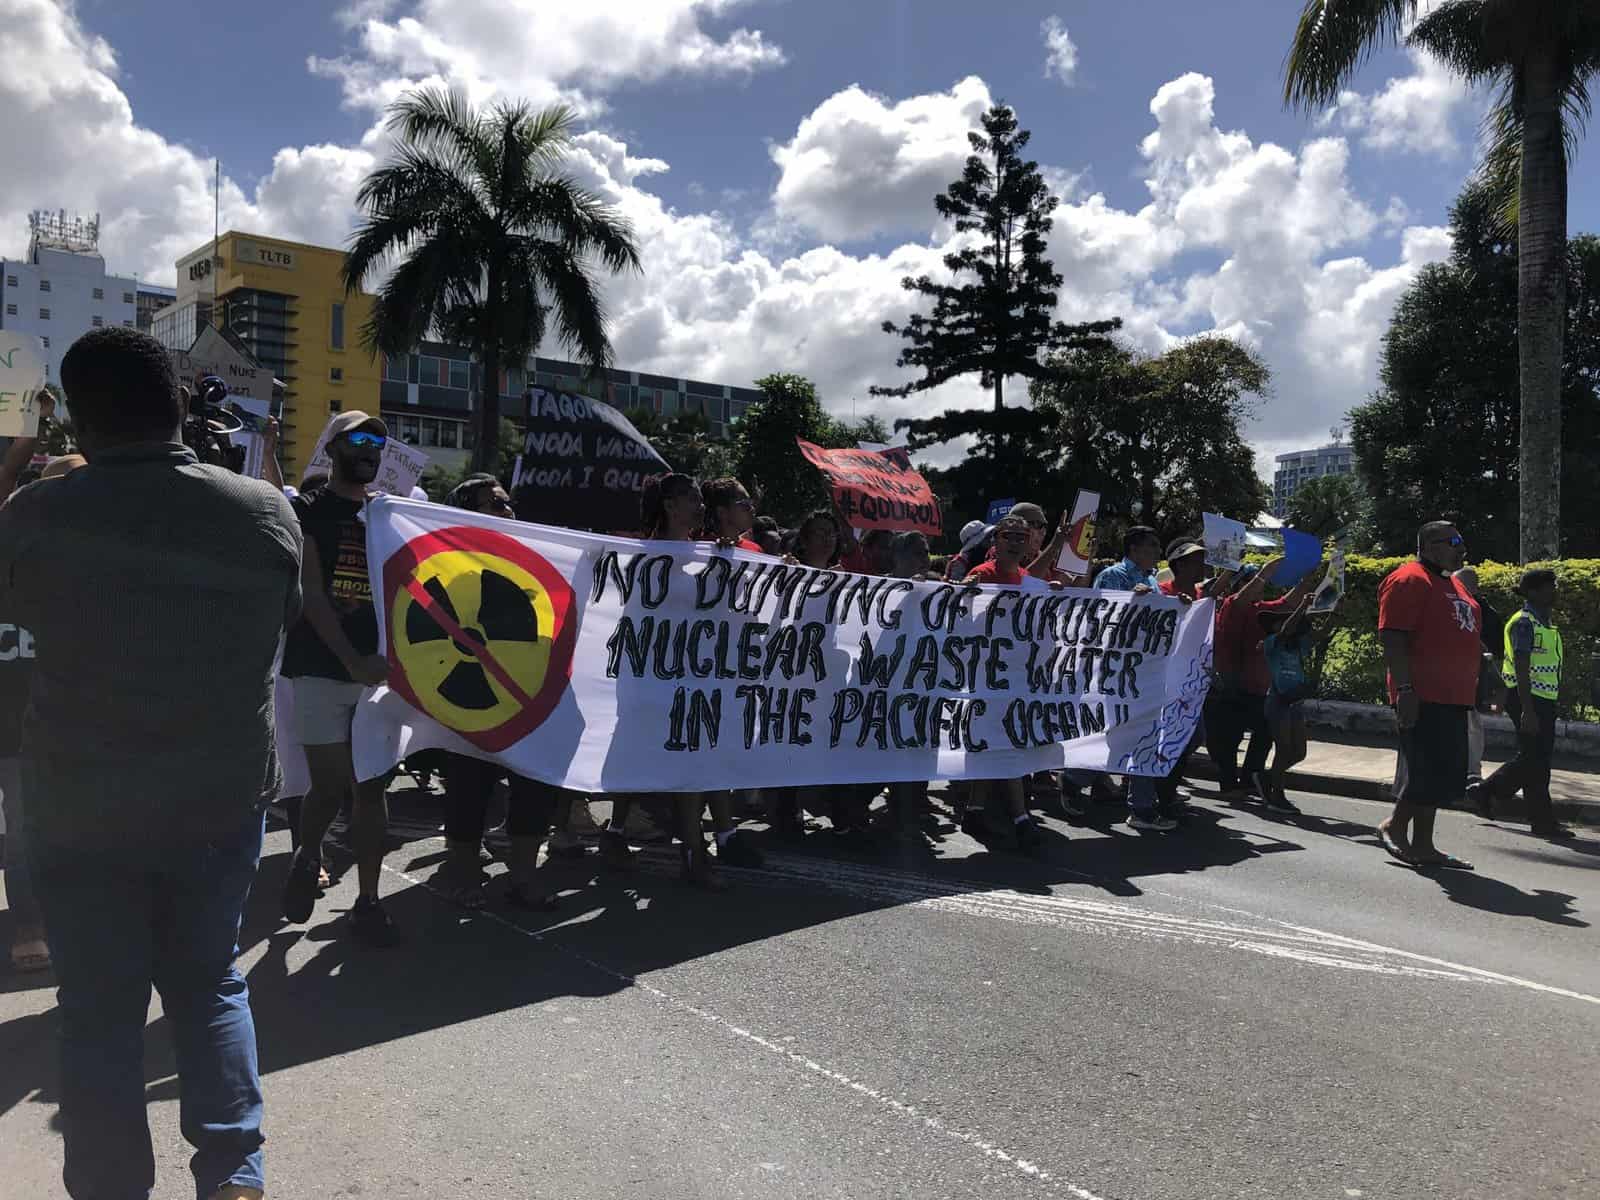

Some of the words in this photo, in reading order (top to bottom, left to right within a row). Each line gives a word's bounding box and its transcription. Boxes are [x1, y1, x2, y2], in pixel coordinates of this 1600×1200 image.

[260, 249, 291, 265] TLTB
[524, 431, 583, 457] NODA
[578, 465, 595, 489] I
[591, 550, 674, 610] NO
[694, 555, 914, 630] DUMPING
[920, 585, 983, 634] OF
[985, 589, 1179, 657] FUKUSHIMA
[606, 615, 828, 683] NUCLEAR
[858, 630, 1014, 695] WASTE
[1025, 641, 1144, 700] WATER
[663, 686, 722, 753] IN
[735, 684, 817, 750] THE
[829, 687, 988, 753] PACIFIC
